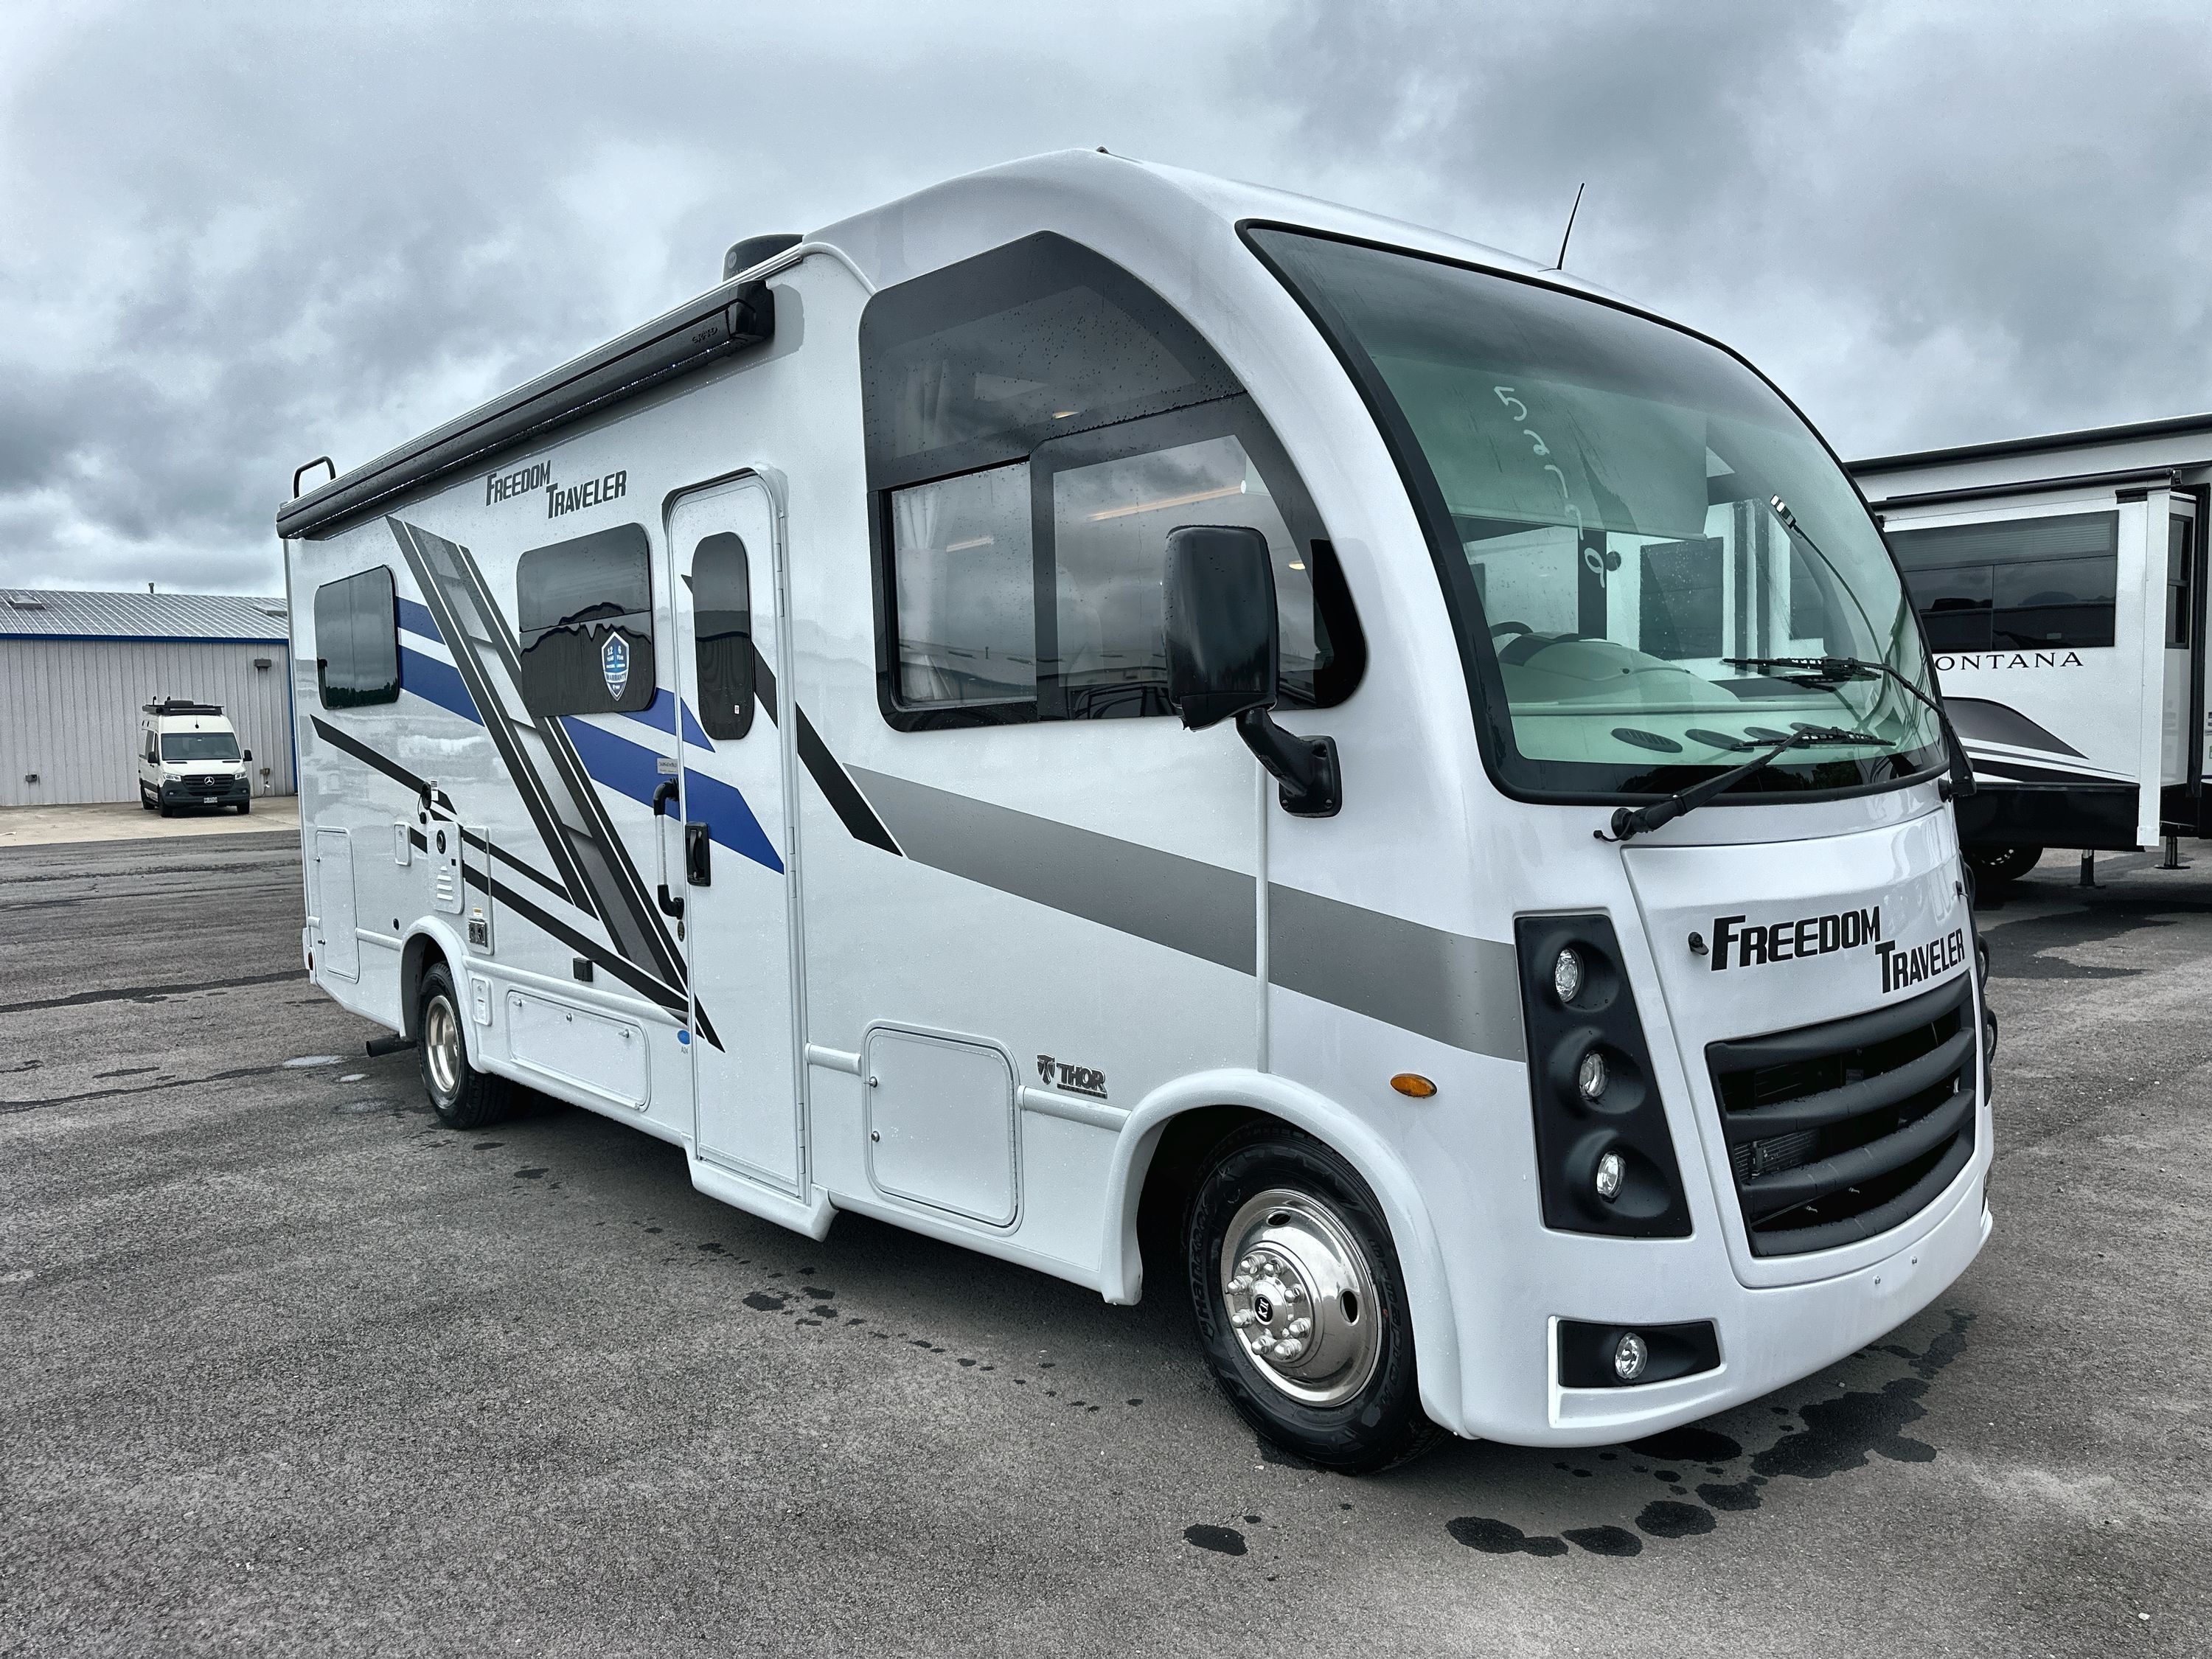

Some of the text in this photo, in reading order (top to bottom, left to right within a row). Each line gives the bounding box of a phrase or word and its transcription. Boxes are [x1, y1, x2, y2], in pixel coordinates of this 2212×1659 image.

[486, 460, 551, 507] FREEDOM
[546, 470, 627, 520] TRAVELER
[607, 645, 622, 656] 12 6
[1935, 651, 2084, 671] ONTANA
[605, 672, 627, 681] WARRANTY
[1711, 905, 1881, 972] FREEDOM
[1875, 928, 1966, 994] TRAVELER
[1057, 1062, 1107, 1093] THOR
